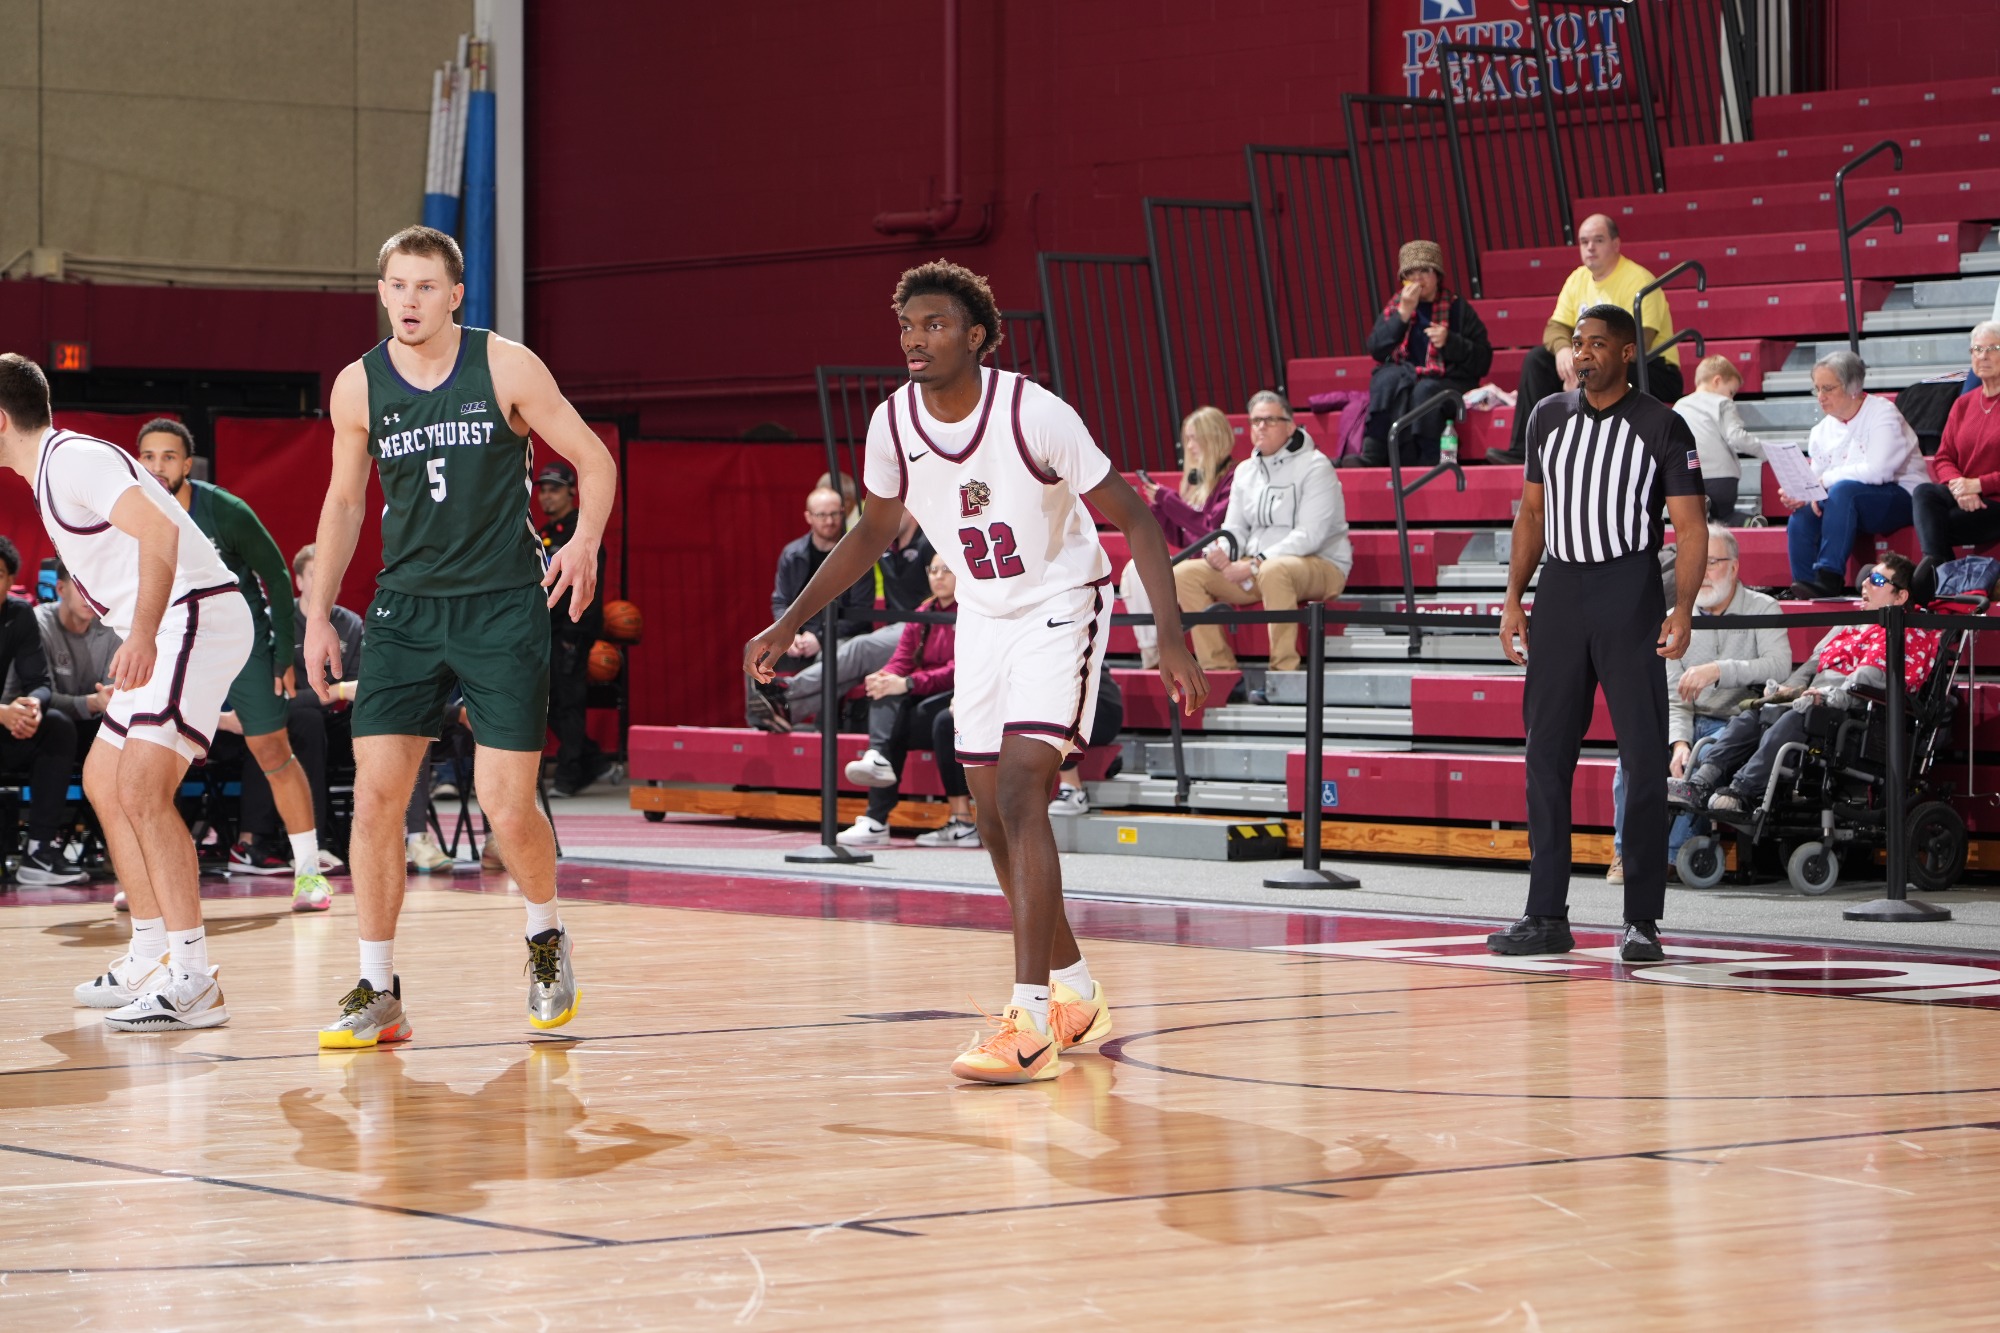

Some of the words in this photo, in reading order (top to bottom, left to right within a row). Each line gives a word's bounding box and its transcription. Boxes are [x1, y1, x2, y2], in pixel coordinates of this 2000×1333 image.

[55, 345, 87, 370] EXIT
[460, 400, 487, 413] NEC
[378, 421, 494, 459] MERCYHURST
[426, 457, 448, 503] 5
[958, 521, 1026, 580] 22
[1250, 934, 2000, 1001] LEO
